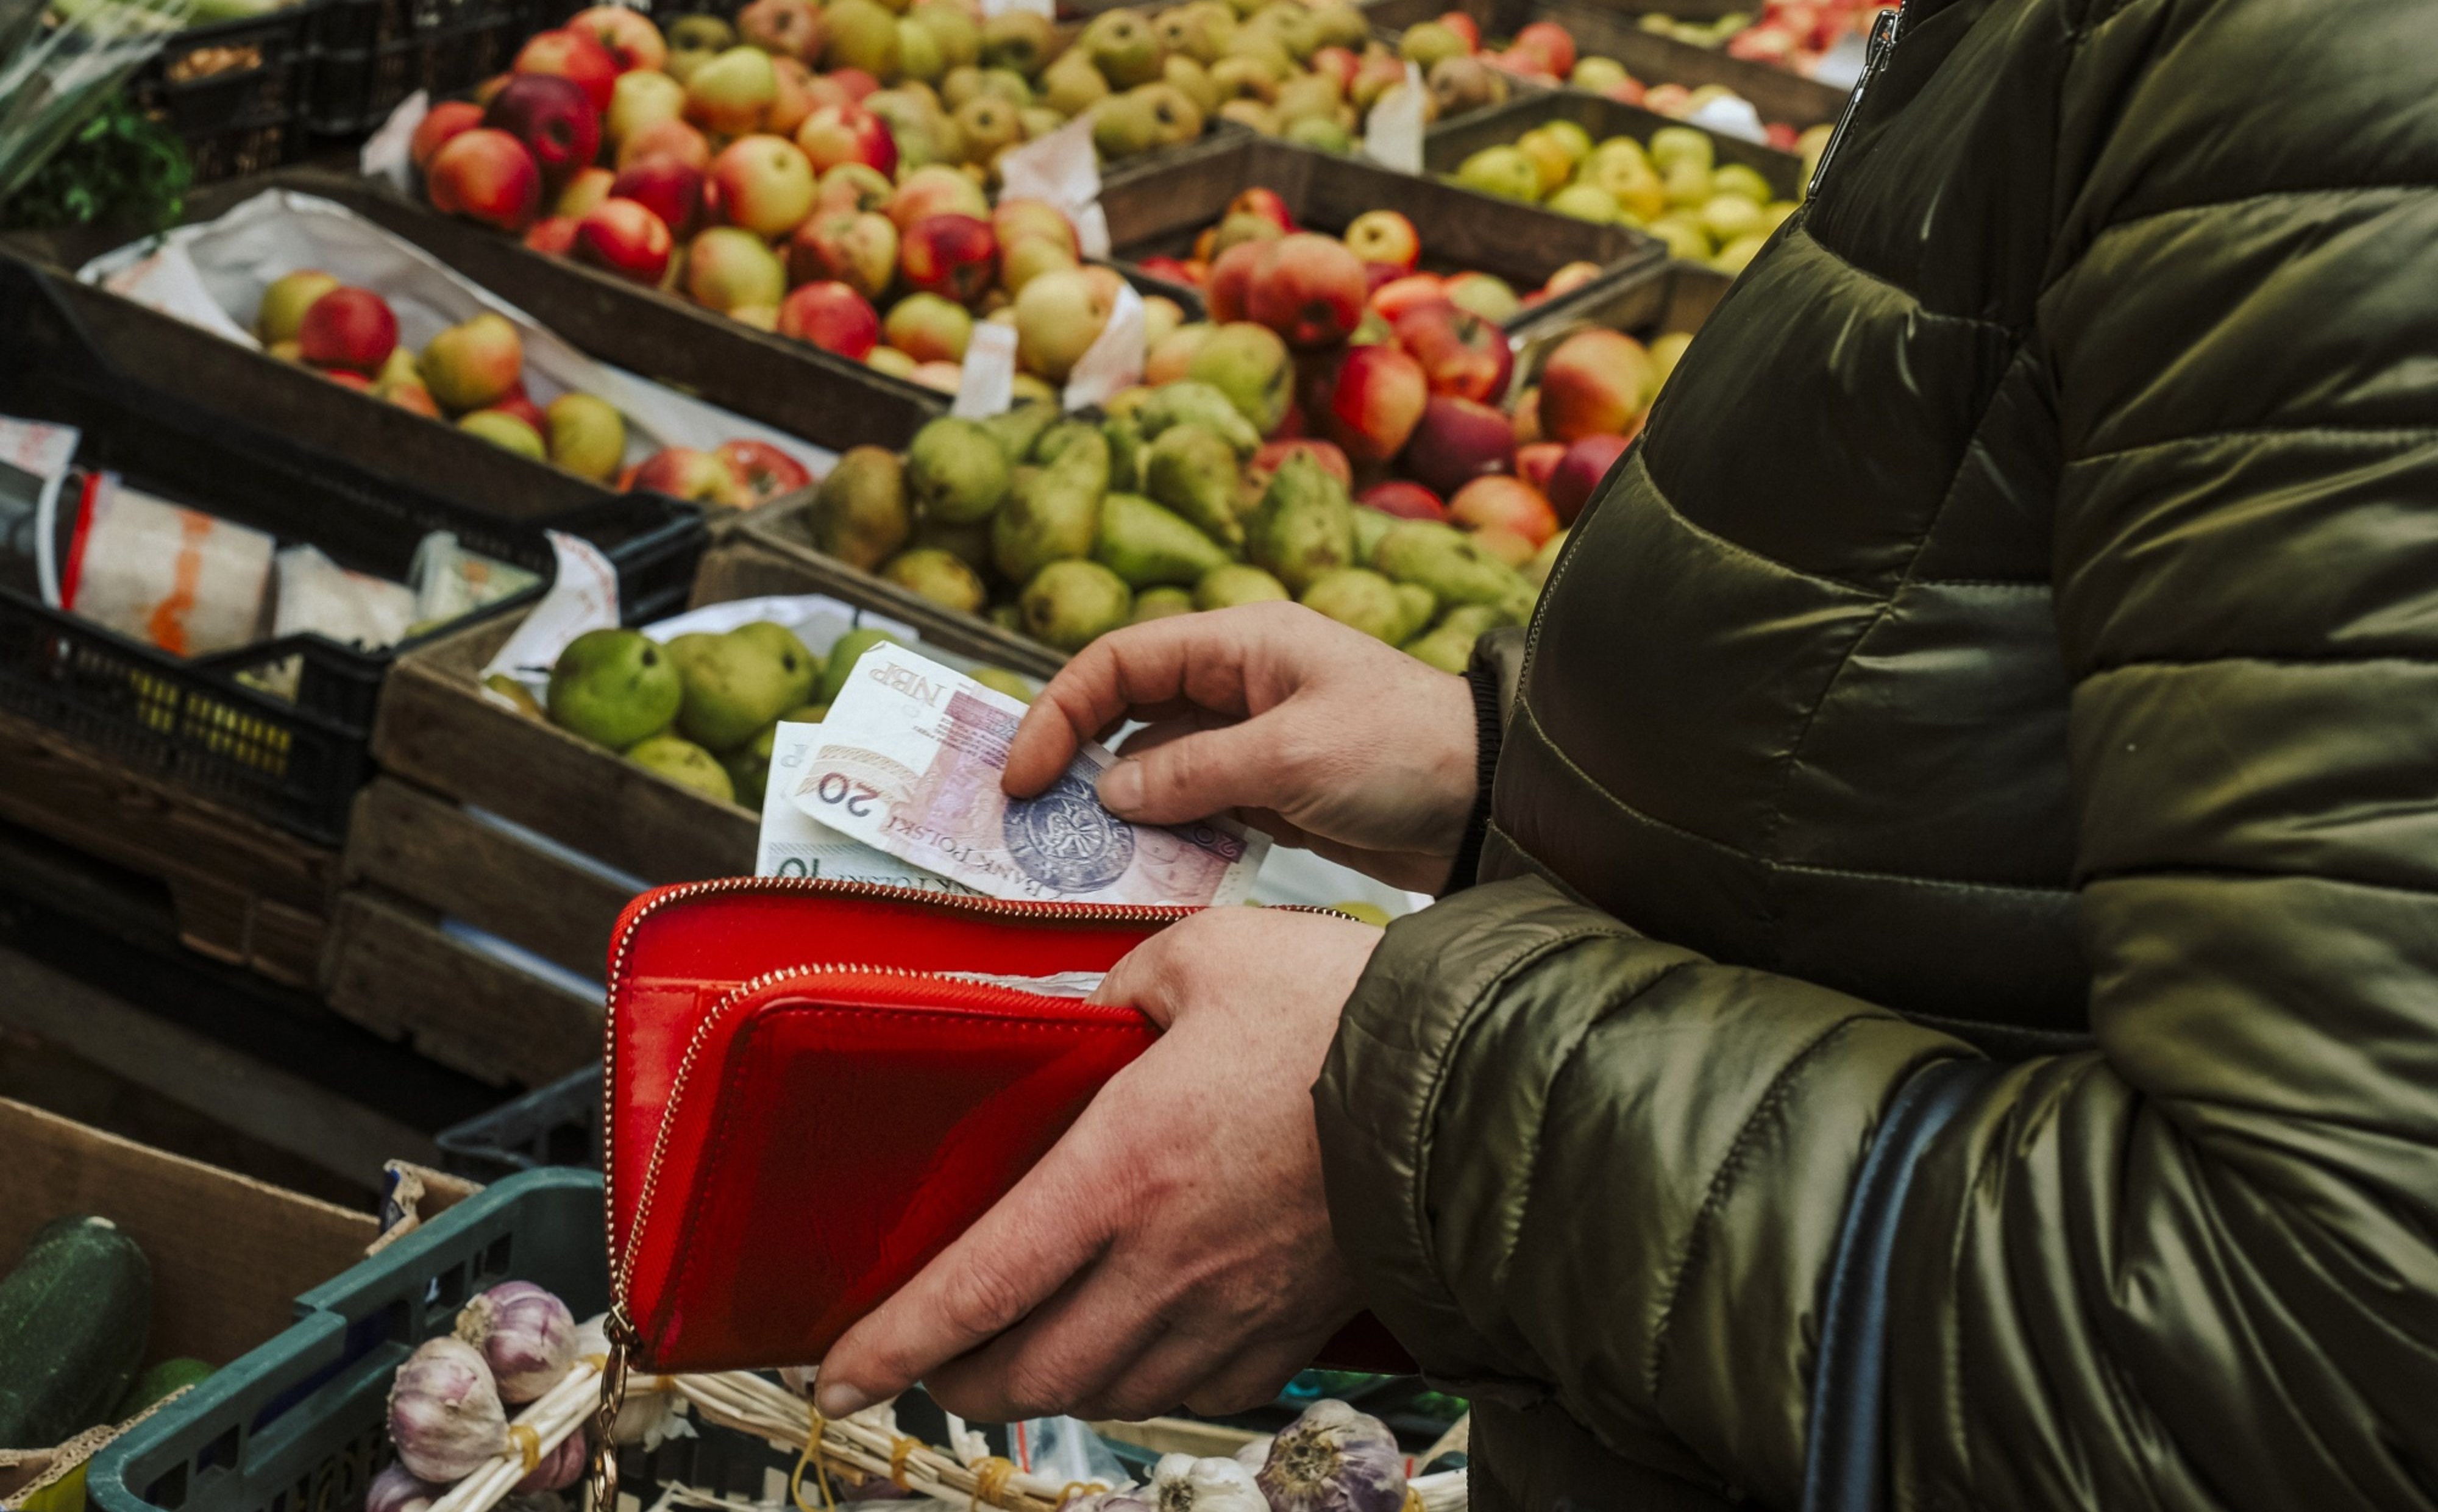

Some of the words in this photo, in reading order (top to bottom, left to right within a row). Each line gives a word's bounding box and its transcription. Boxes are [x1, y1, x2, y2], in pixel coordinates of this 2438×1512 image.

[869, 661, 948, 708] NBP
[819, 772, 879, 817] 20
[886, 816, 974, 862] POLSKI
[1194, 825, 1241, 858] 20
[976, 851, 1040, 896] BANK
